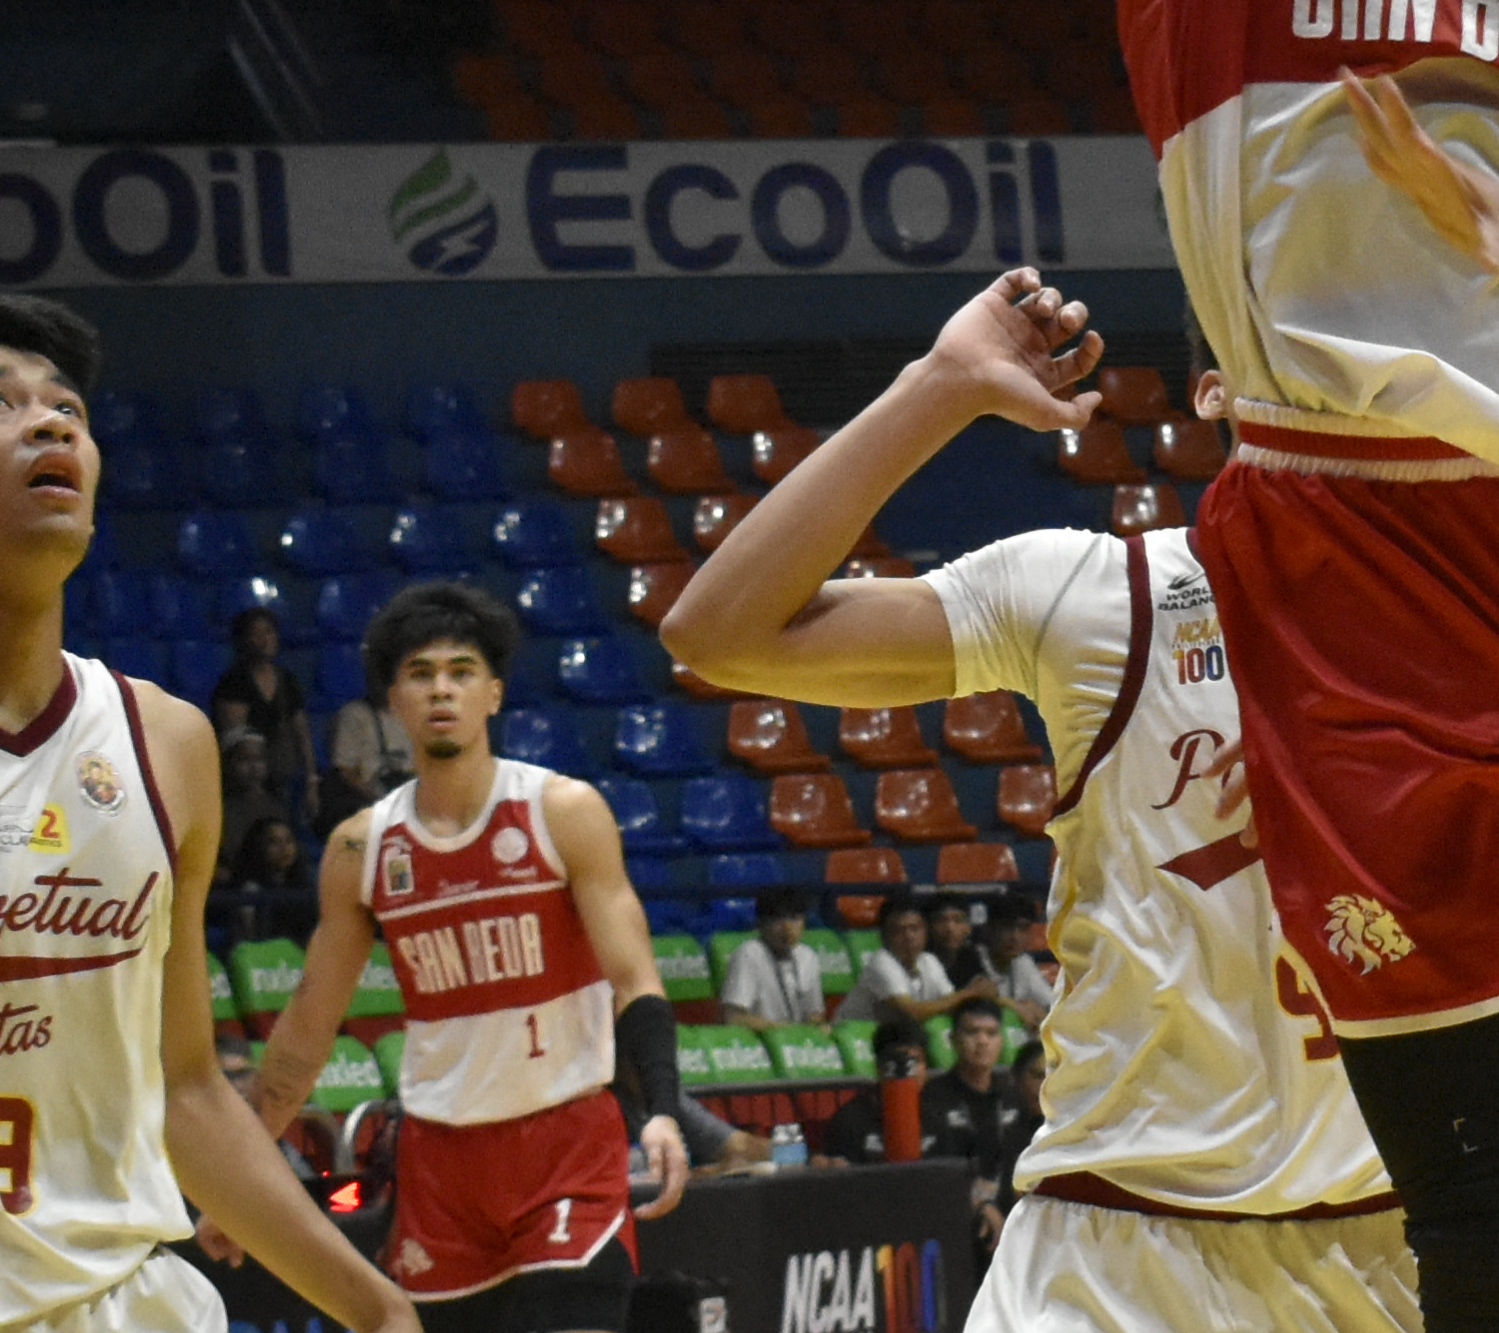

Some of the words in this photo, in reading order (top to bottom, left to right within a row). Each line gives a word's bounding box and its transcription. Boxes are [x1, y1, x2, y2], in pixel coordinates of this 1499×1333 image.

[524, 141, 1066, 272] EcoOil
[1166, 586, 1212, 601] WORL
[1171, 644, 1225, 685] 100
[41, 809, 60, 839] 2
[396, 926, 470, 996] SAN
[461, 912, 546, 985] BEDA
[525, 1013, 546, 1059] 1
[547, 1198, 573, 1244] 1
